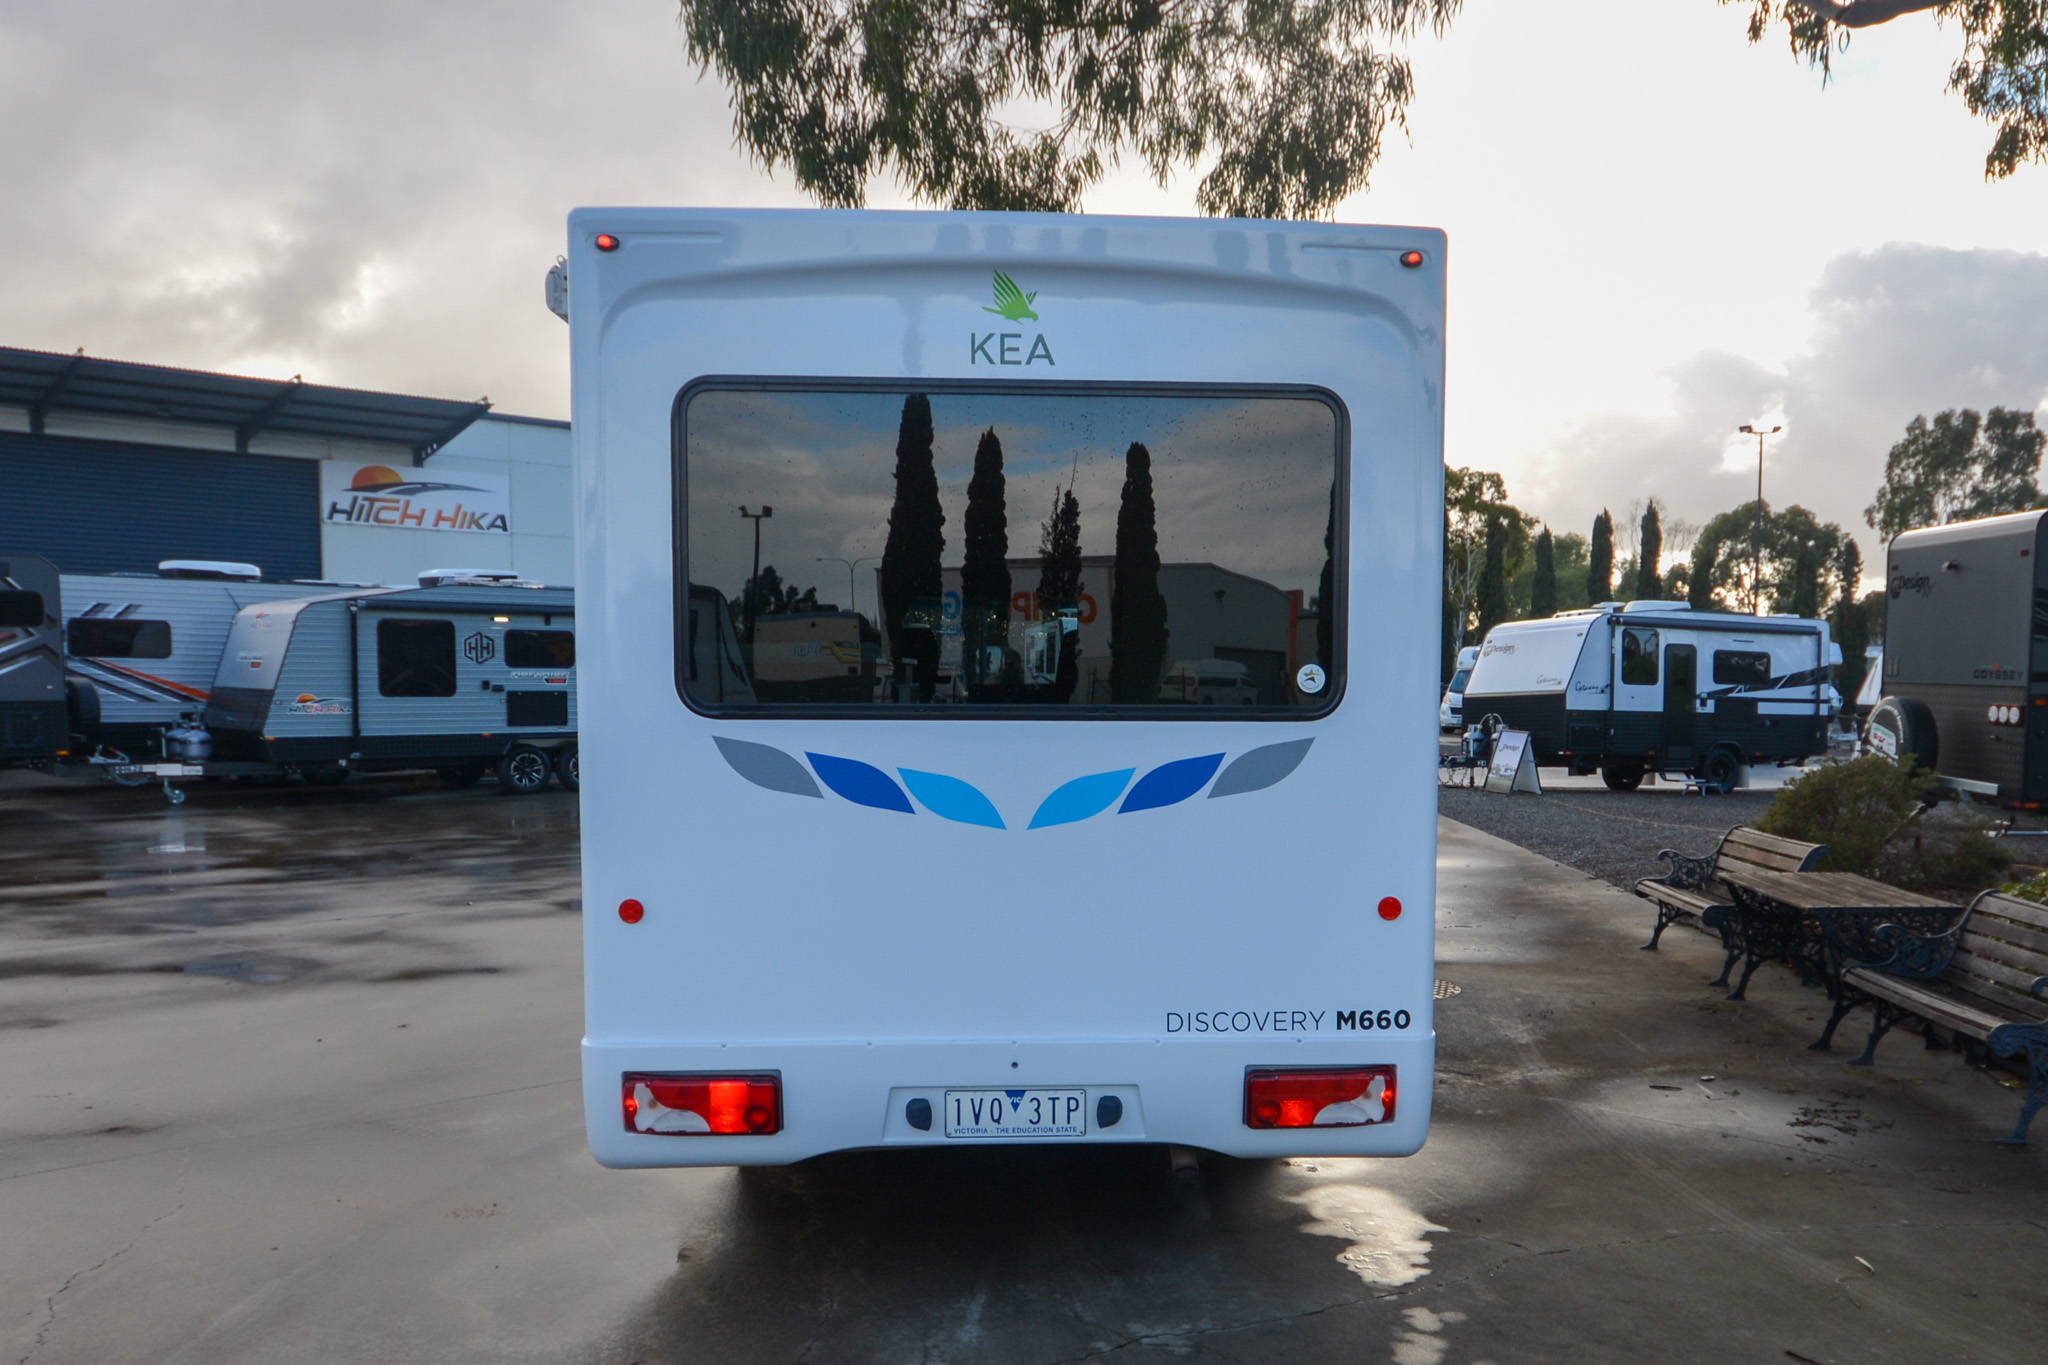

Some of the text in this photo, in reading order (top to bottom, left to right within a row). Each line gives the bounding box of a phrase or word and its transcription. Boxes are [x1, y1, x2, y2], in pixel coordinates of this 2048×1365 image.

[970, 332, 1055, 366] KEA
[326, 495, 509, 532] HITCH HIKA
[1973, 669, 2024, 680] ODYSSEY
[1166, 1009, 1412, 1033] DISCOVERY M660
[954, 1096, 1080, 1126] 1VQ 3TP
[1008, 1096, 1023, 1104] VIC
